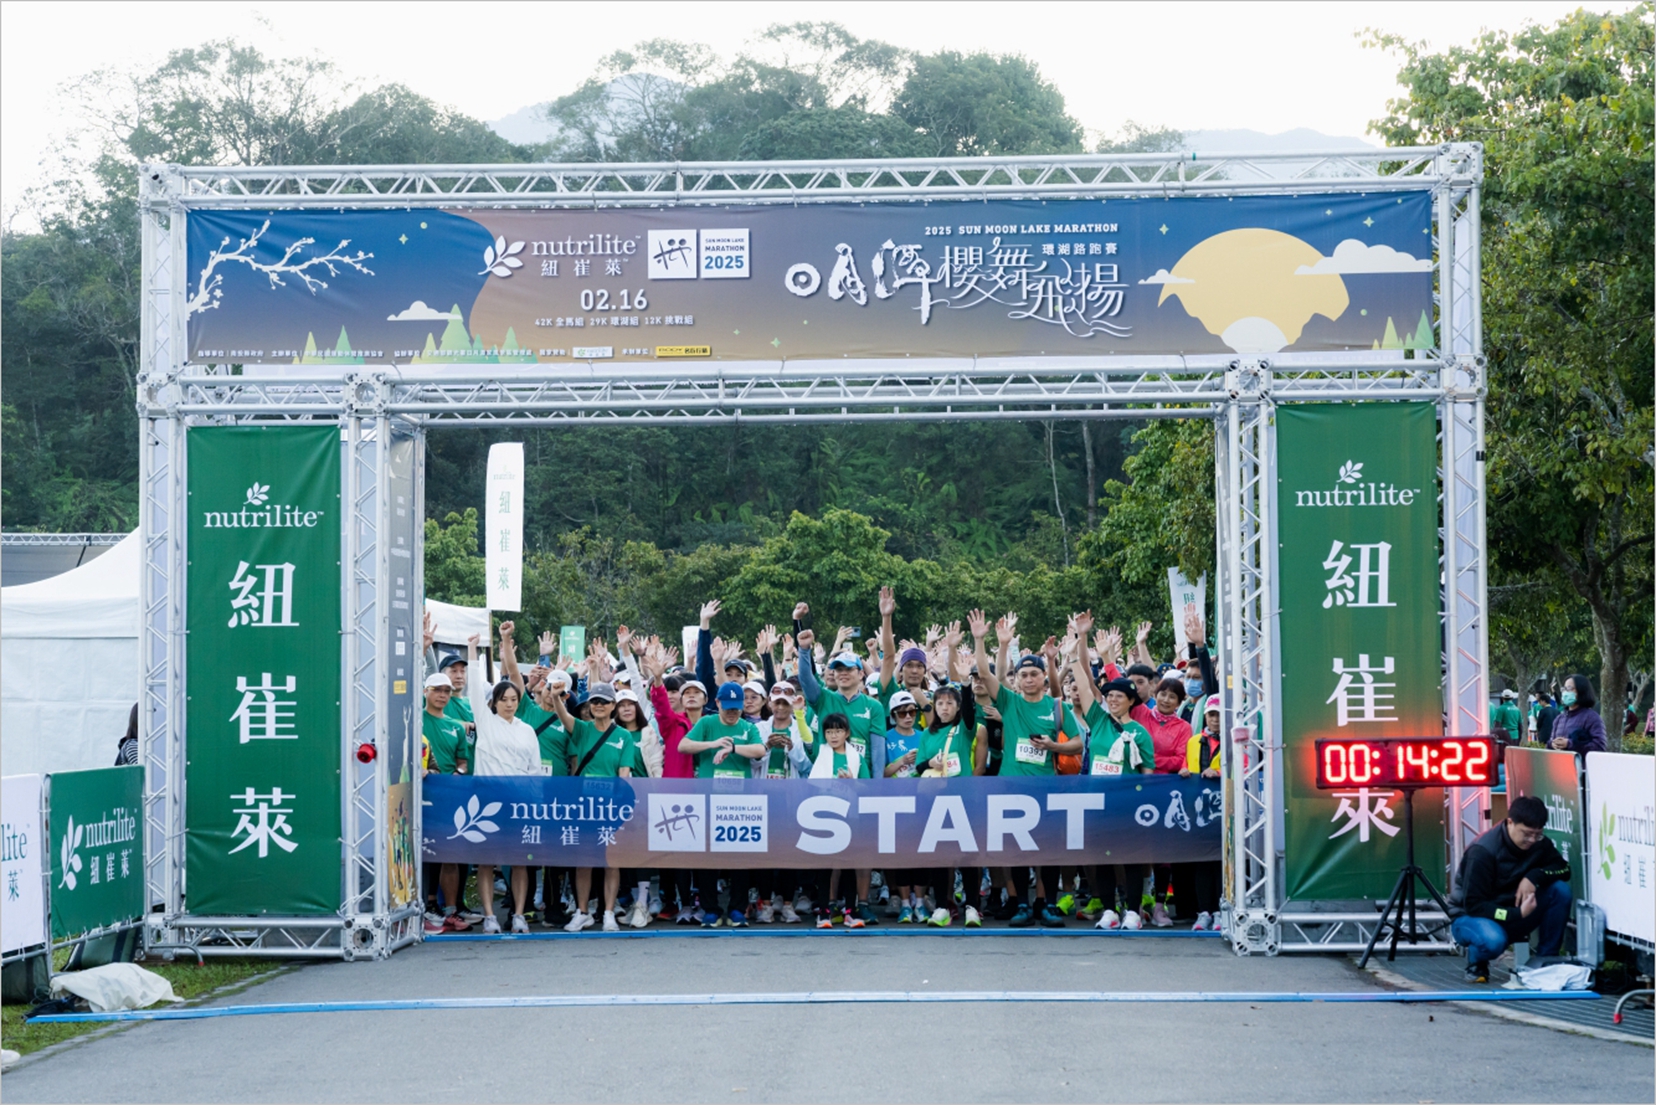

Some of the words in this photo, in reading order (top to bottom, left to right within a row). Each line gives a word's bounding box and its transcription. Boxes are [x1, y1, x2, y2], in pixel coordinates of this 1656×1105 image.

[925, 226, 952, 236] 2025
[958, 225, 982, 235] SUN
[985, 225, 1018, 234] MOON
[1021, 224, 1051, 234] LAKE
[1054, 223, 1118, 233] MARATHON
[531, 234, 637, 257] nutrilite
[1042, 242, 1118, 256] 環湖路跑賽
[541, 259, 622, 277] 紐崔萊
[704, 255, 744, 270] 2025
[580, 288, 648, 312] 02.16
[535, 318, 553, 327] 42K
[556, 317, 584, 328] 全馬組
[590, 317, 607, 326] 29K
[610, 316, 639, 327] 環湖組
[645, 316, 662, 325] 12K
[665, 315, 693, 326] 挑戰組
[1295, 482, 1415, 507] nutrilite
[204, 504, 318, 529] nutrilite
[228, 560, 300, 858] 紐崔萊
[1019, 745, 1044, 757] 10393
[1324, 741, 1488, 784] 00:14:22
[1095, 762, 1120, 773] 15483
[510, 796, 634, 822] nutrilite
[715, 814, 763, 822] MARATHON
[85, 807, 137, 849] nutrilite
[521, 824, 617, 847] 紐崔萊
[715, 825, 762, 842] 2025
[796, 793, 1105, 855] START
[90, 848, 130, 885] 紐崔萊
